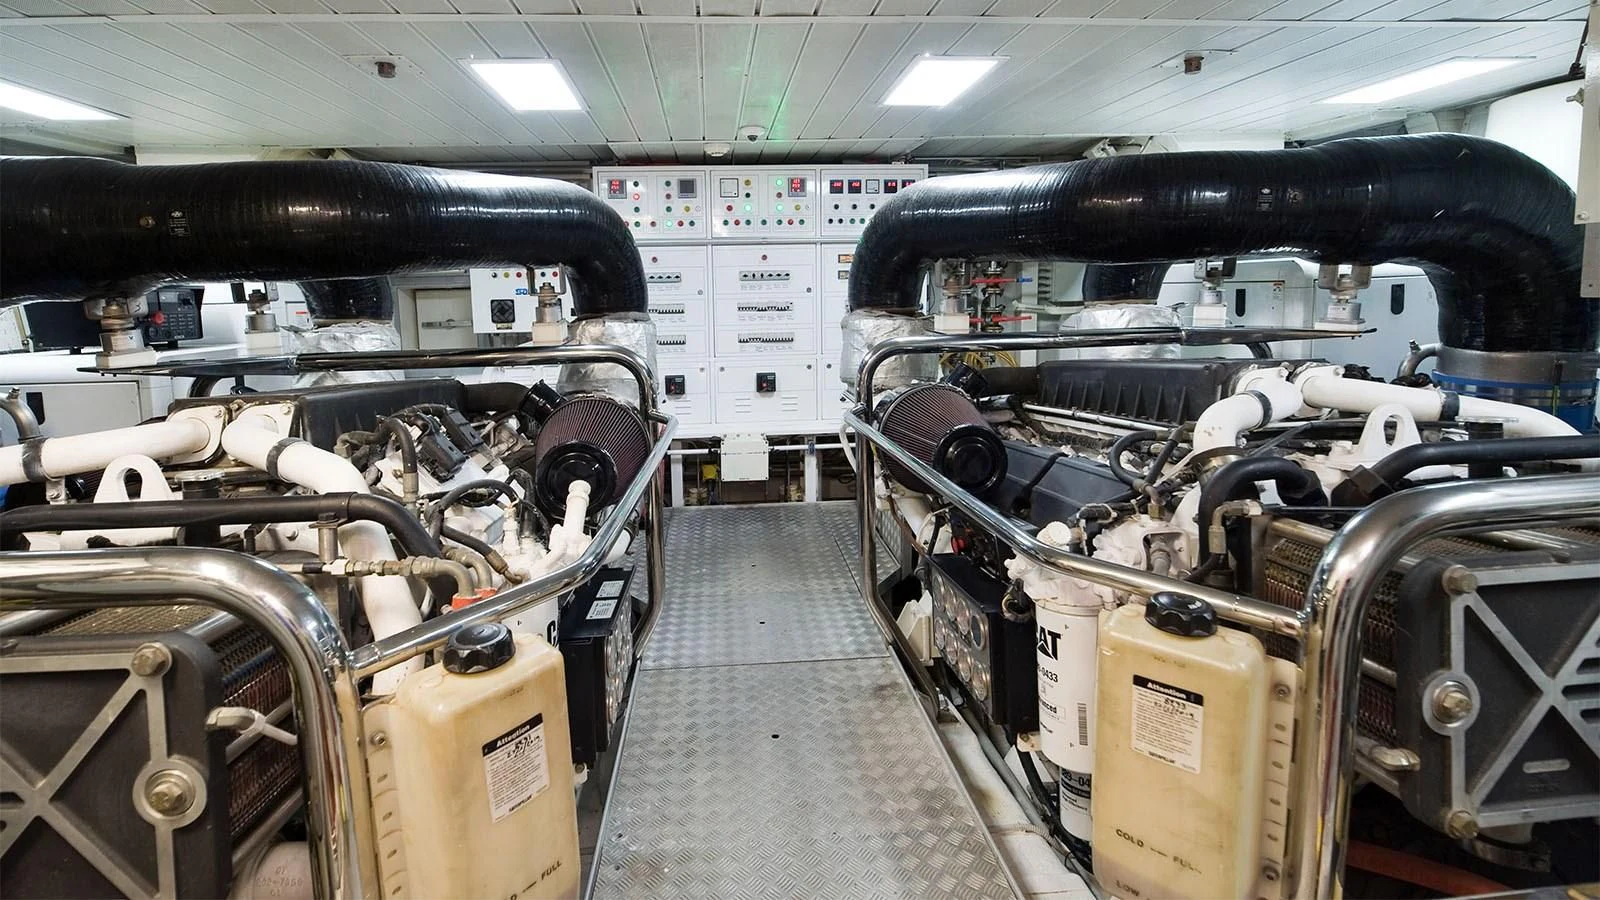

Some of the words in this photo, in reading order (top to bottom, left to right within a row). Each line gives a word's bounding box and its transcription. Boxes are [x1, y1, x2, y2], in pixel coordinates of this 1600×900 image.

[1036, 625, 1062, 661] AT
[1037, 664, 1059, 683] -0433
[1146, 681, 1187, 700] Attention
[1040, 698, 1058, 714] nced
[496, 724, 530, 748] Attention
[1115, 828, 1145, 848] COLD
[541, 860, 562, 880] FULL
[1116, 879, 1140, 897] LOW
